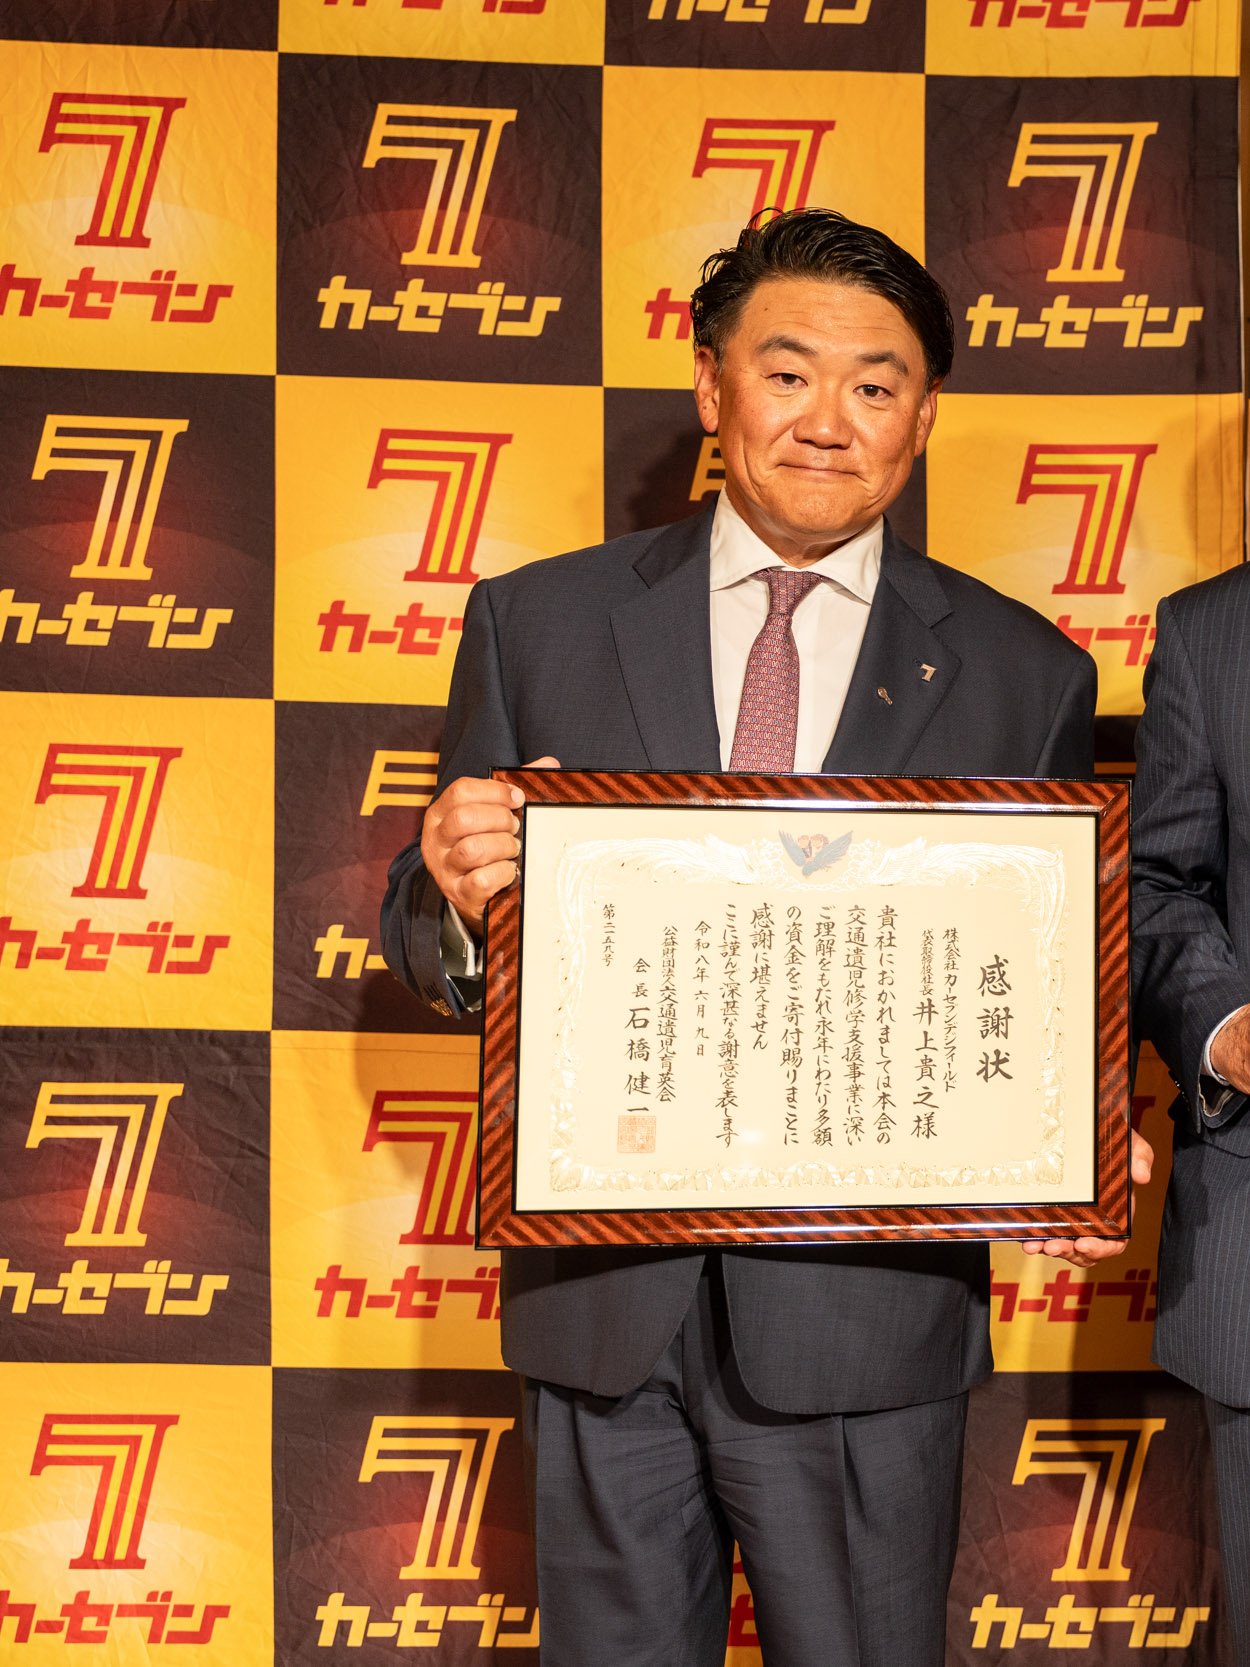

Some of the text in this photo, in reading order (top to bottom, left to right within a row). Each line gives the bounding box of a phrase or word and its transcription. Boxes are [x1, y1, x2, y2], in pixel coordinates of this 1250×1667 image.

[0, 263, 234, 324] カーセブン
[317, 275, 562, 337] カーセブン
[966, 294, 1204, 348] カーセブン
[0, 588, 234, 649] カーセブン
[317, 600, 464, 656] カーセ
[0, 916, 230, 975] カーセブン
[749, 902, 776, 1050] 感謝に堪えません
[715, 904, 742, 1147] ここに謹んで深甚なる謝意を表します
[780, 905, 806, 1146] の資金をご寄付賜りまことに
[811, 905, 836, 1147] ご理解をもたれ永年にわたり多額
[841, 904, 868, 1146] 交通遺児修学支援事業に深い
[872, 904, 898, 1145] 貴社におかれましては本会の
[976, 953, 1014, 1083] 感謝状
[0, 1258, 229, 1316] カーセブン
[314, 1264, 500, 1320] カーセブ
[990, 1268, 1157, 1322] カーセブ
[0, 1590, 230, 1644] カーセブン
[315, 1592, 540, 1648] カーセブン
[969, 1594, 1210, 1649] カーセブン
